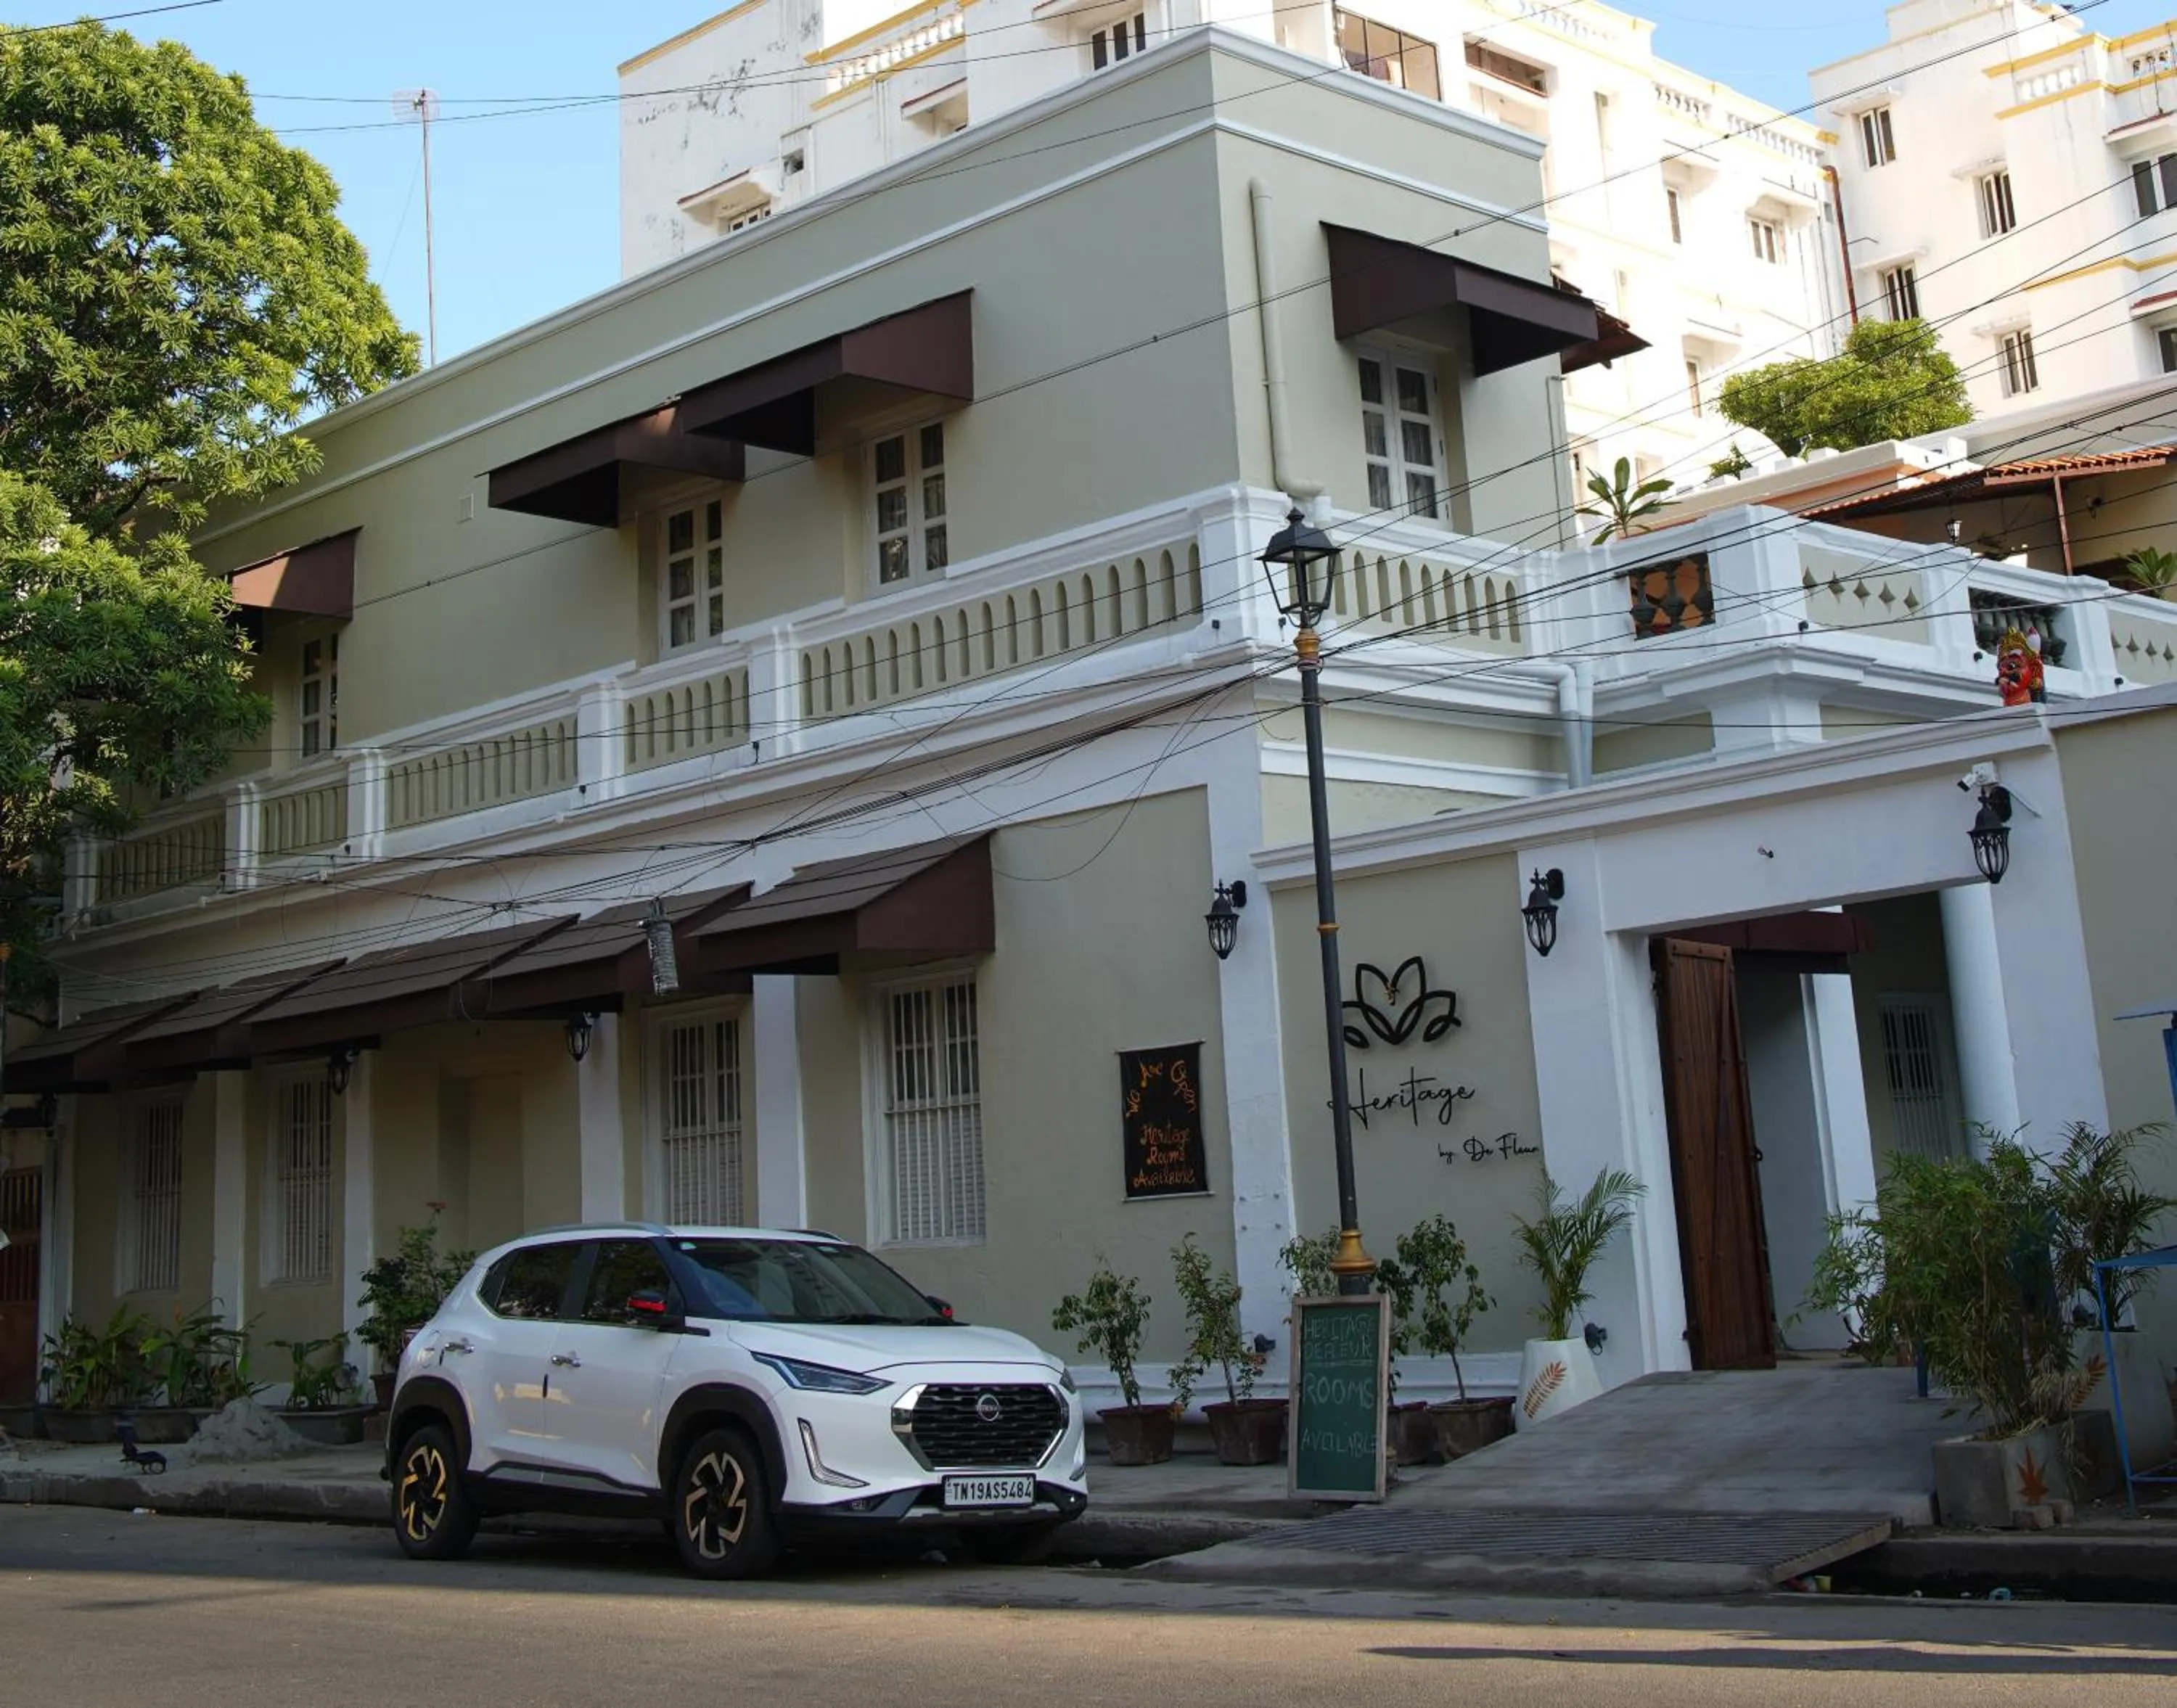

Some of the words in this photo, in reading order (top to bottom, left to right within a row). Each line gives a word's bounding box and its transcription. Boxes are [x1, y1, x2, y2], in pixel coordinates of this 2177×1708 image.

[1327, 1067, 1476, 1130] Heritage
[1438, 1143, 1459, 1165] by
[1302, 1372, 1374, 1409] ROOMS
[953, 1481, 1031, 1501] TN19AS5484
